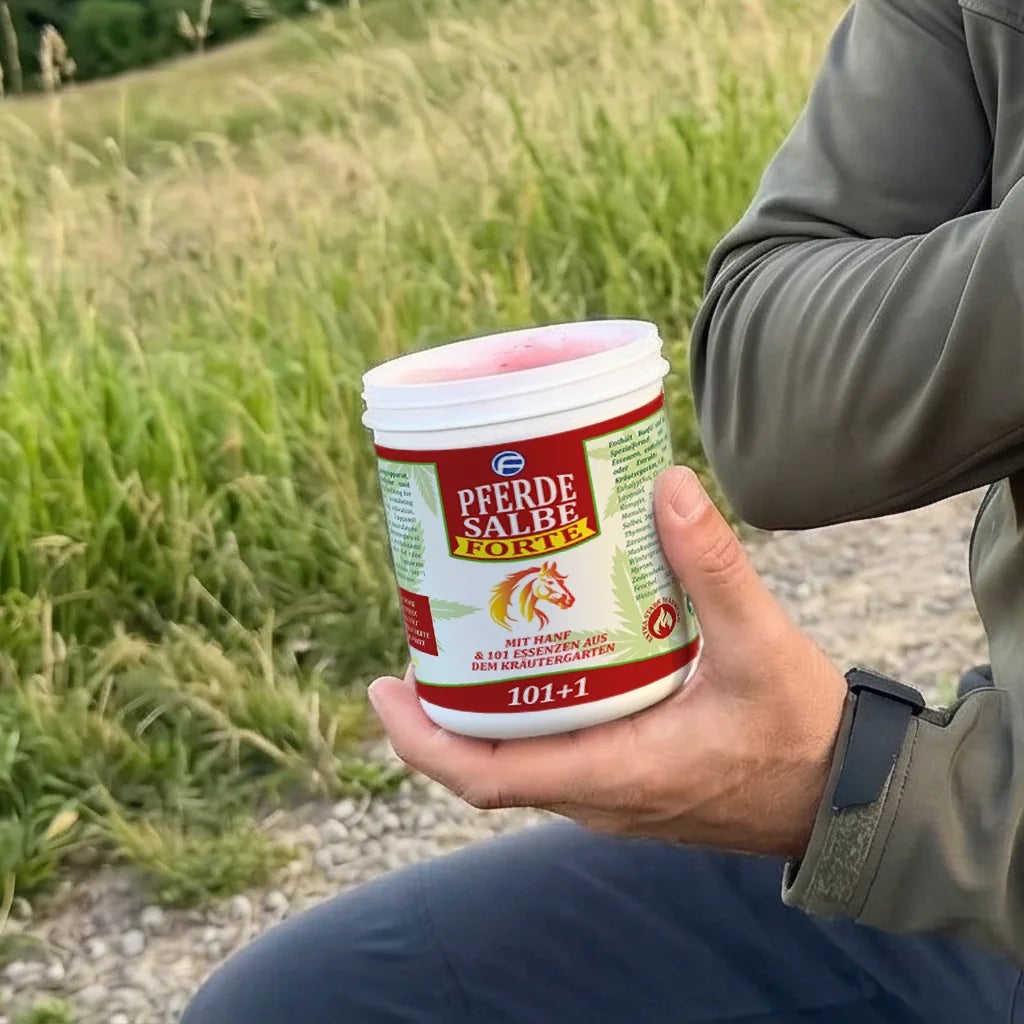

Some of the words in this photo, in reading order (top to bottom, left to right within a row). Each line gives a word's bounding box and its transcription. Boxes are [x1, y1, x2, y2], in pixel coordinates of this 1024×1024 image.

[457, 474, 577, 517] PFERDE
[463, 501, 579, 538] SALBE
[466, 524, 583, 556] FORTE
[474, 651, 484, 660] &
[488, 650, 508, 660] 101
[513, 639, 581, 659] ESSENZEN
[583, 633, 608, 648] AUS
[505, 636, 530, 648] MIT
[534, 630, 572, 645] HANF
[472, 661, 497, 671] DEM
[501, 643, 616, 671] KRÄUTERGARTEN
[508, 677, 589, 706] 101+1
